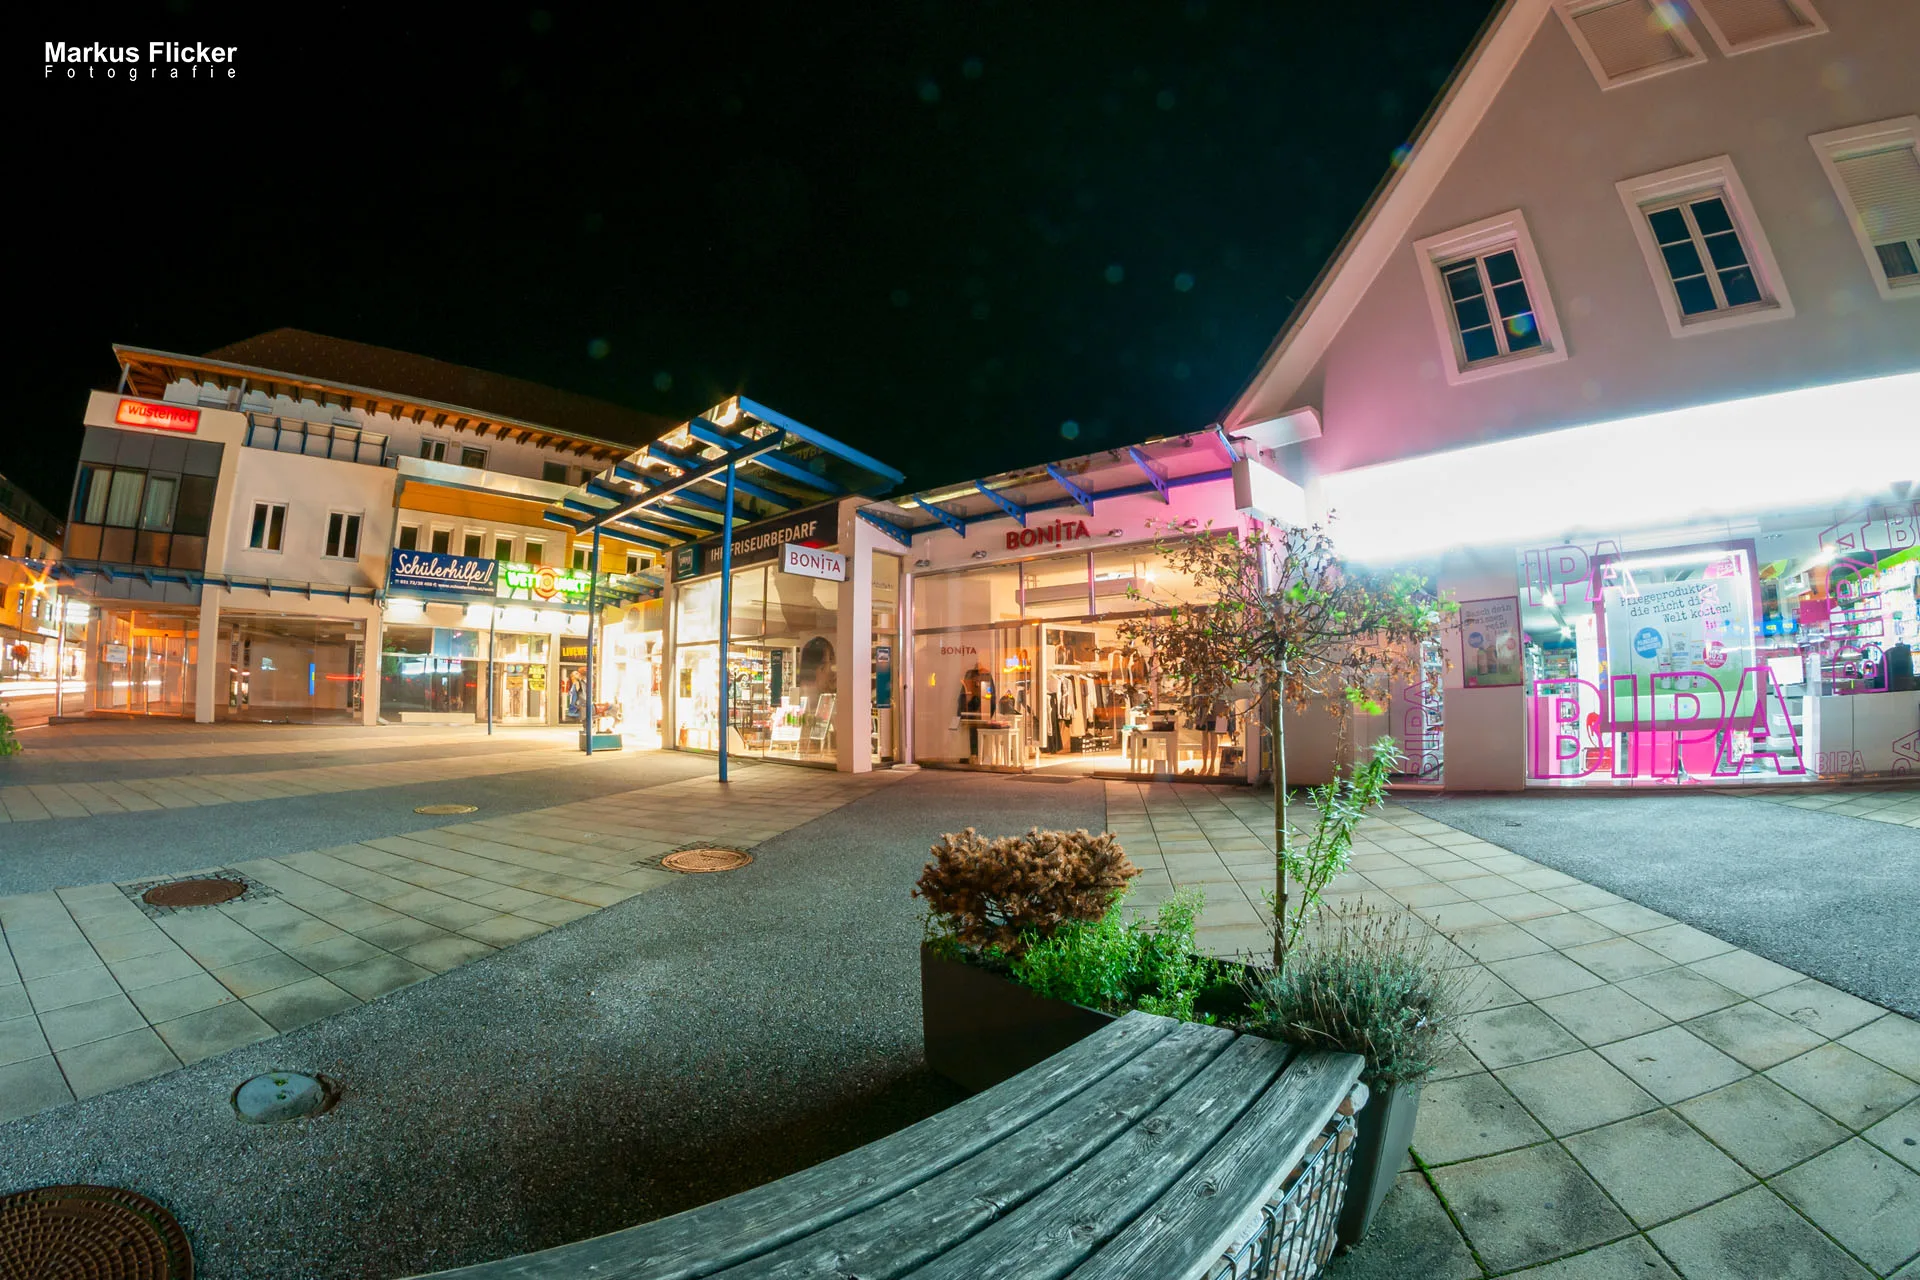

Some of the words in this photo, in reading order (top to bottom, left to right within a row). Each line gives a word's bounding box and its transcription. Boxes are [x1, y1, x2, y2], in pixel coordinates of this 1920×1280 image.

[730, 520, 818, 557] FRISEURBEDARF
[1630, 606, 1650, 618] die
[1653, 600, 1685, 614] nicht
[1663, 610, 1688, 624] Welt
[1532, 666, 1806, 779] BIPA
[1814, 751, 1867, 775] BIPA
